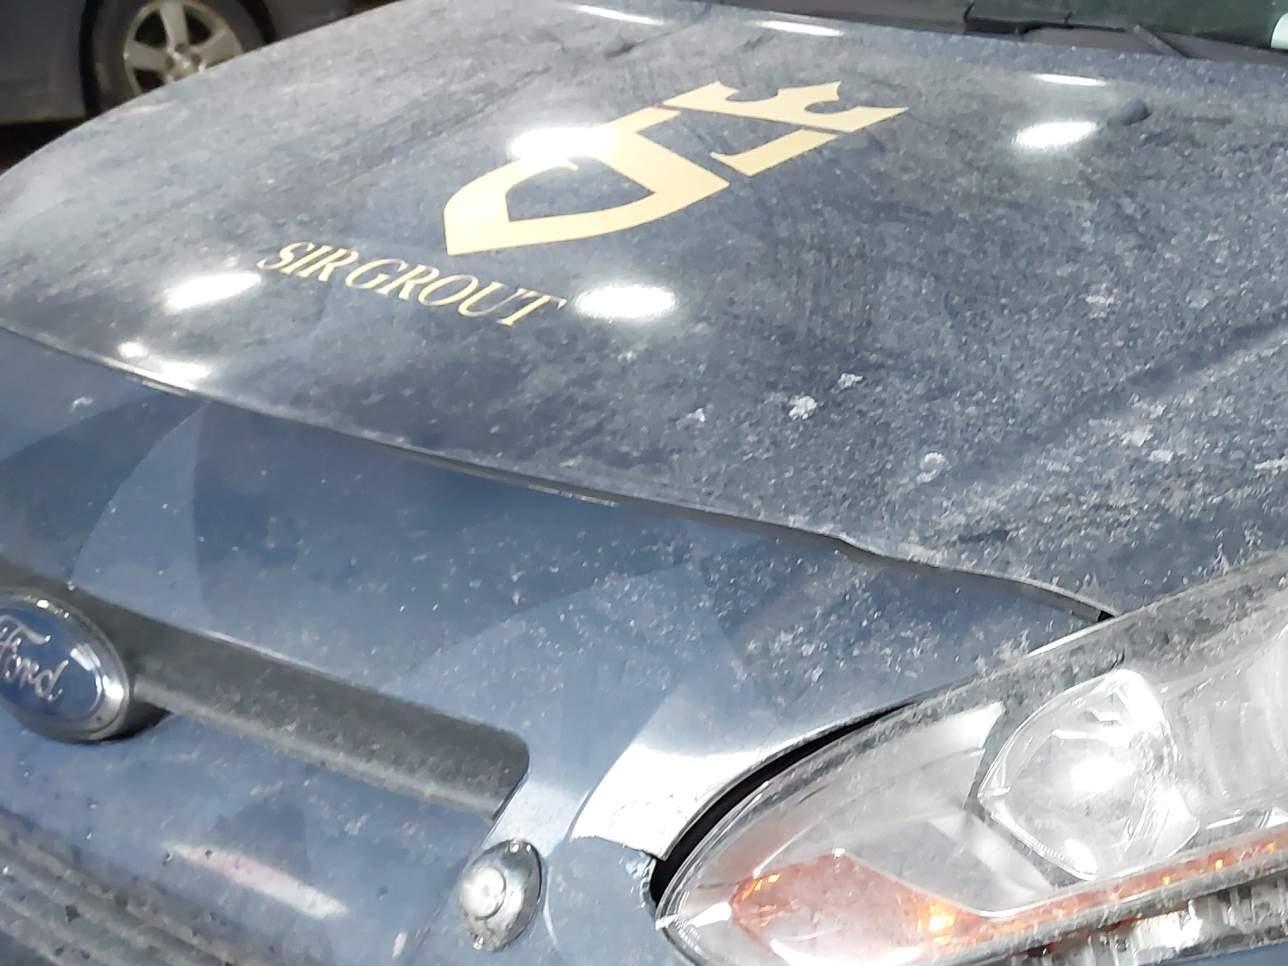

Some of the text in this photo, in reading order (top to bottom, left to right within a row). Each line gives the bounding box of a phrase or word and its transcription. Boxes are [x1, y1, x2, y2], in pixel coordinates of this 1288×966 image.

[257, 241, 567, 328] SIR GROUT
[0, 614, 69, 702] Ford
